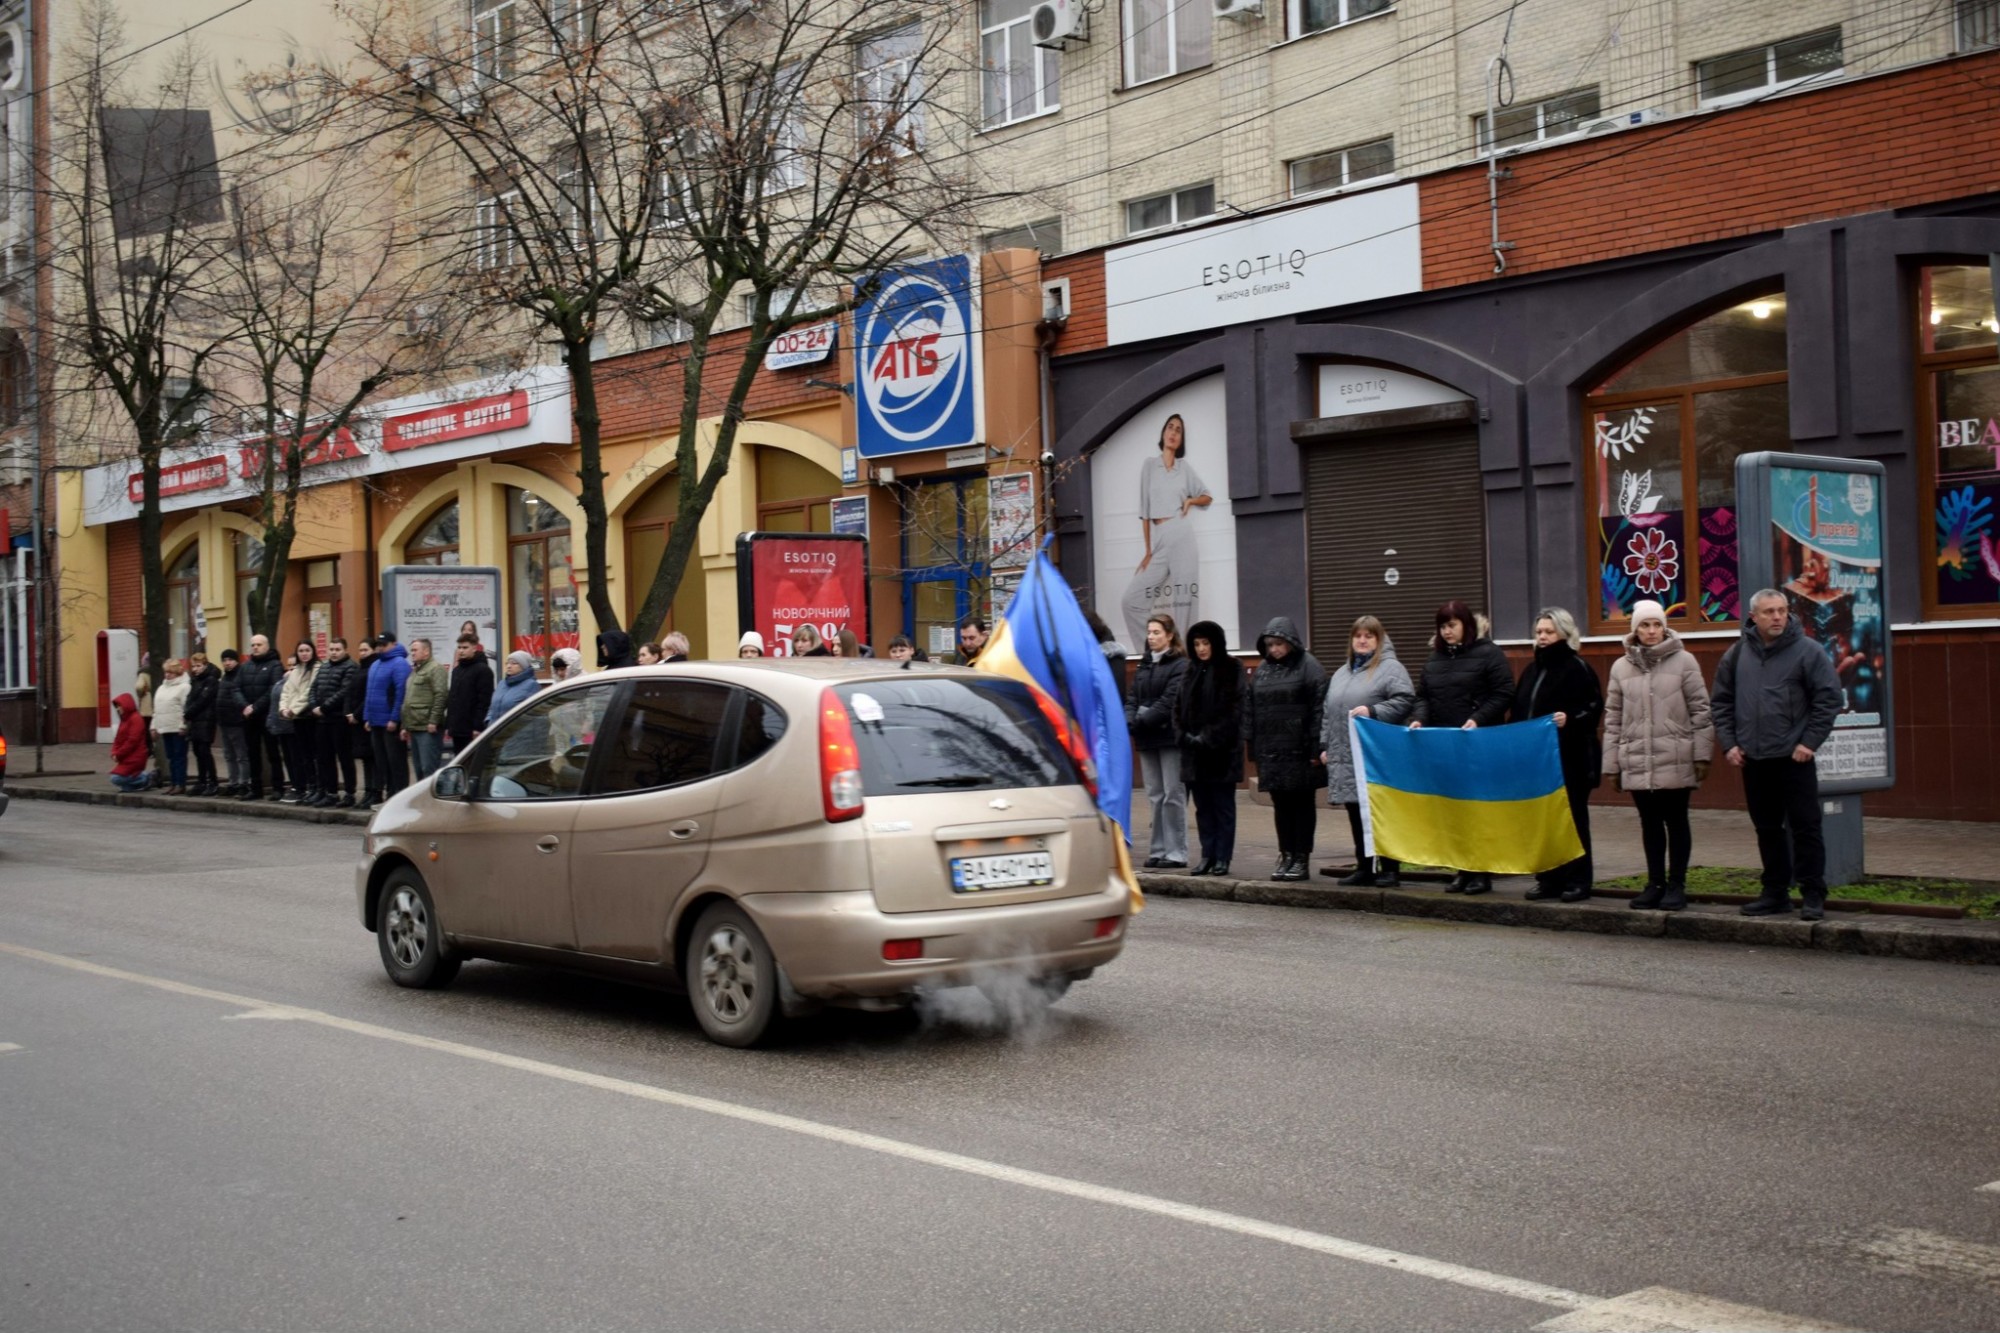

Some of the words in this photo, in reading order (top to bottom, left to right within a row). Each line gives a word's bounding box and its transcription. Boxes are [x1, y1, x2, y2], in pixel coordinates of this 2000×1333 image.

[1203, 249, 1305, 286] ESOTIQ
[1216, 289, 1250, 302] жіноча
[1252, 281, 1291, 296] білизна
[776, 328, 827, 354] 00-24
[874, 332, 941, 383] АТБ
[1340, 379, 1387, 395] ESOTIQ
[463, 402, 511, 428] ВЗУТТЯ
[784, 552, 837, 566] ESOTIQ
[1145, 583, 1199, 598] ESOTIQ
[403, 608, 438, 617] MARIA
[773, 605, 851, 619] НОВОРІЧНИЙ
